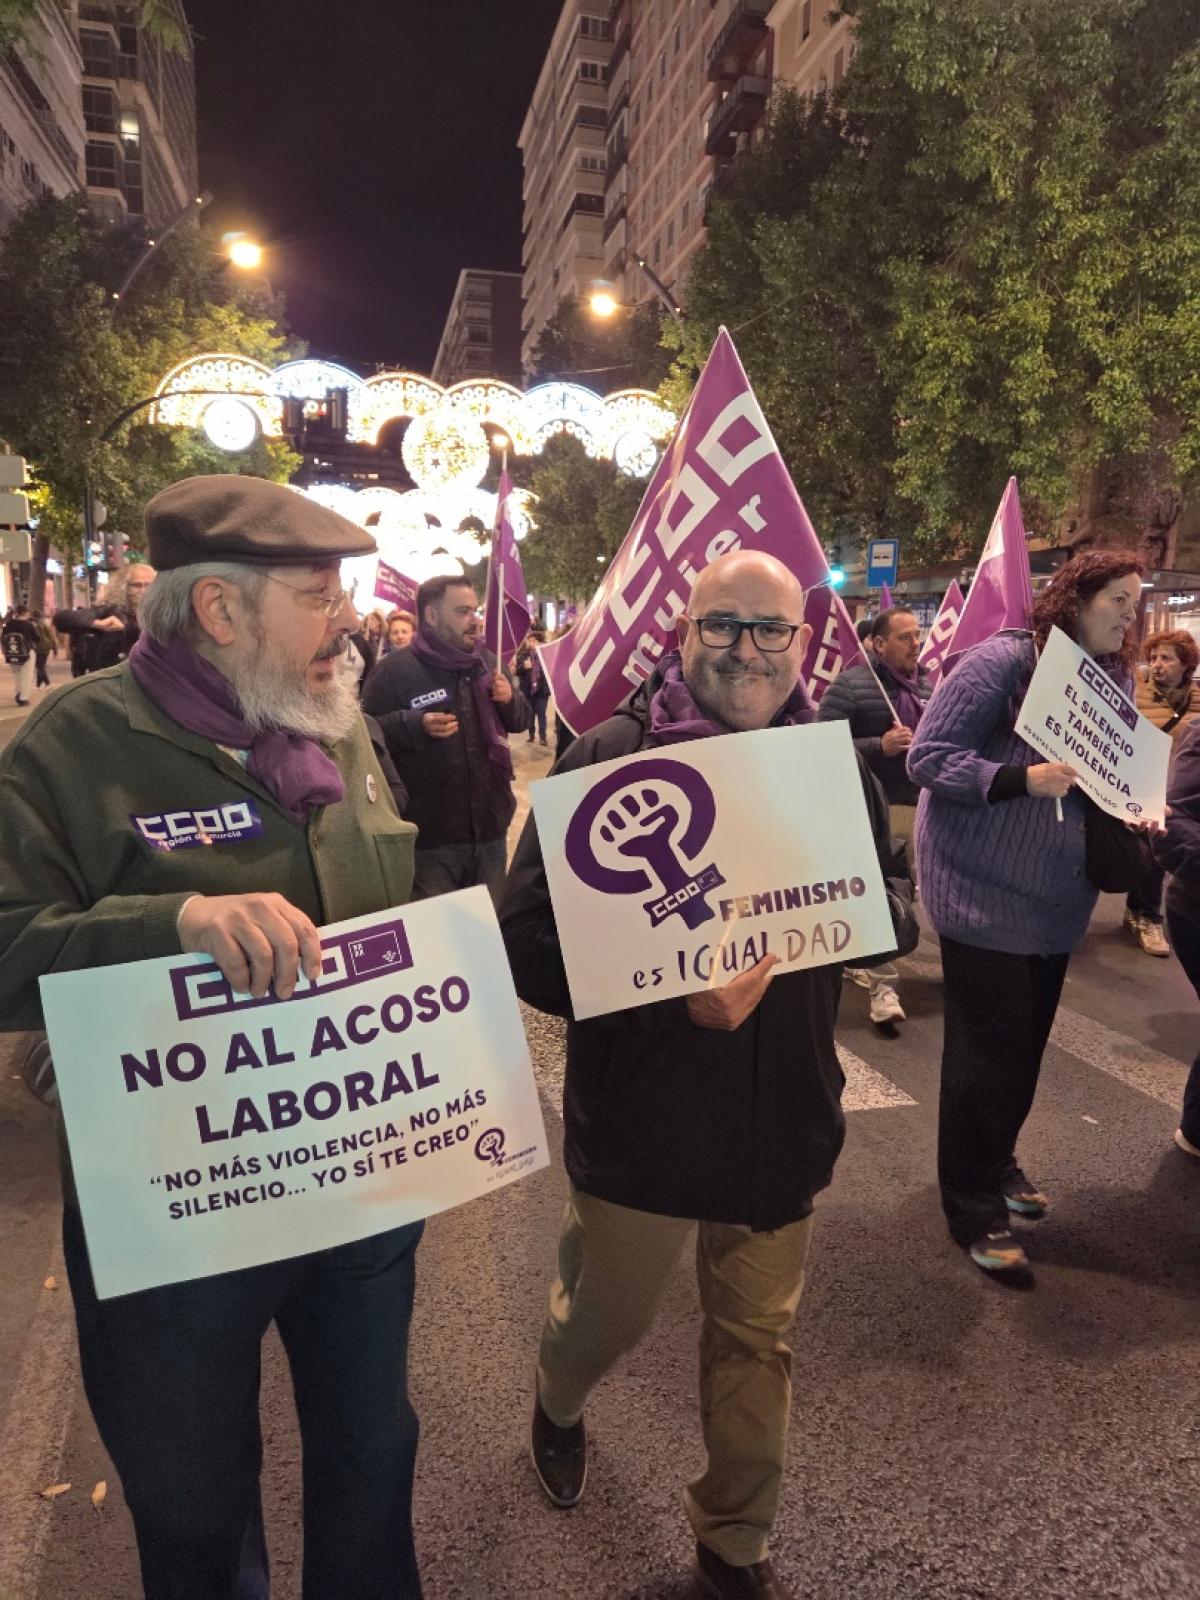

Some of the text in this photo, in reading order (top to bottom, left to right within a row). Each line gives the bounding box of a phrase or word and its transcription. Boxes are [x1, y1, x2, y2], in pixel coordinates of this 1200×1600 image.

[569, 391, 778, 704] CCOO
[411, 689, 448, 708] CCOO
[1081, 664, 1123, 712] CCOO
[1064, 684, 1134, 757] EL SILENCIO
[1067, 711, 1120, 767] TAMBIÉN
[1045, 715, 1062, 736] ES
[1064, 731, 1131, 797] VIOLENCIA
[136, 803, 253, 838] CCOO
[652, 881, 701, 918] CCOO
[719, 877, 866, 922] FEMINISMO
[634, 920, 851, 989] es IGUALDAD
[120, 975, 471, 1093] NO AL ACOSO
[195, 1052, 440, 1144] LABORAL
[209, 1154, 262, 1182] MÁS
[267, 1122, 404, 1171] VIOLENCIA,
[409, 1107, 441, 1131] NO
[446, 1089, 487, 1118] MÁS
[311, 1165, 347, 1188] YO
[353, 1153, 375, 1177] SÍ
[379, 1146, 408, 1169] TE
